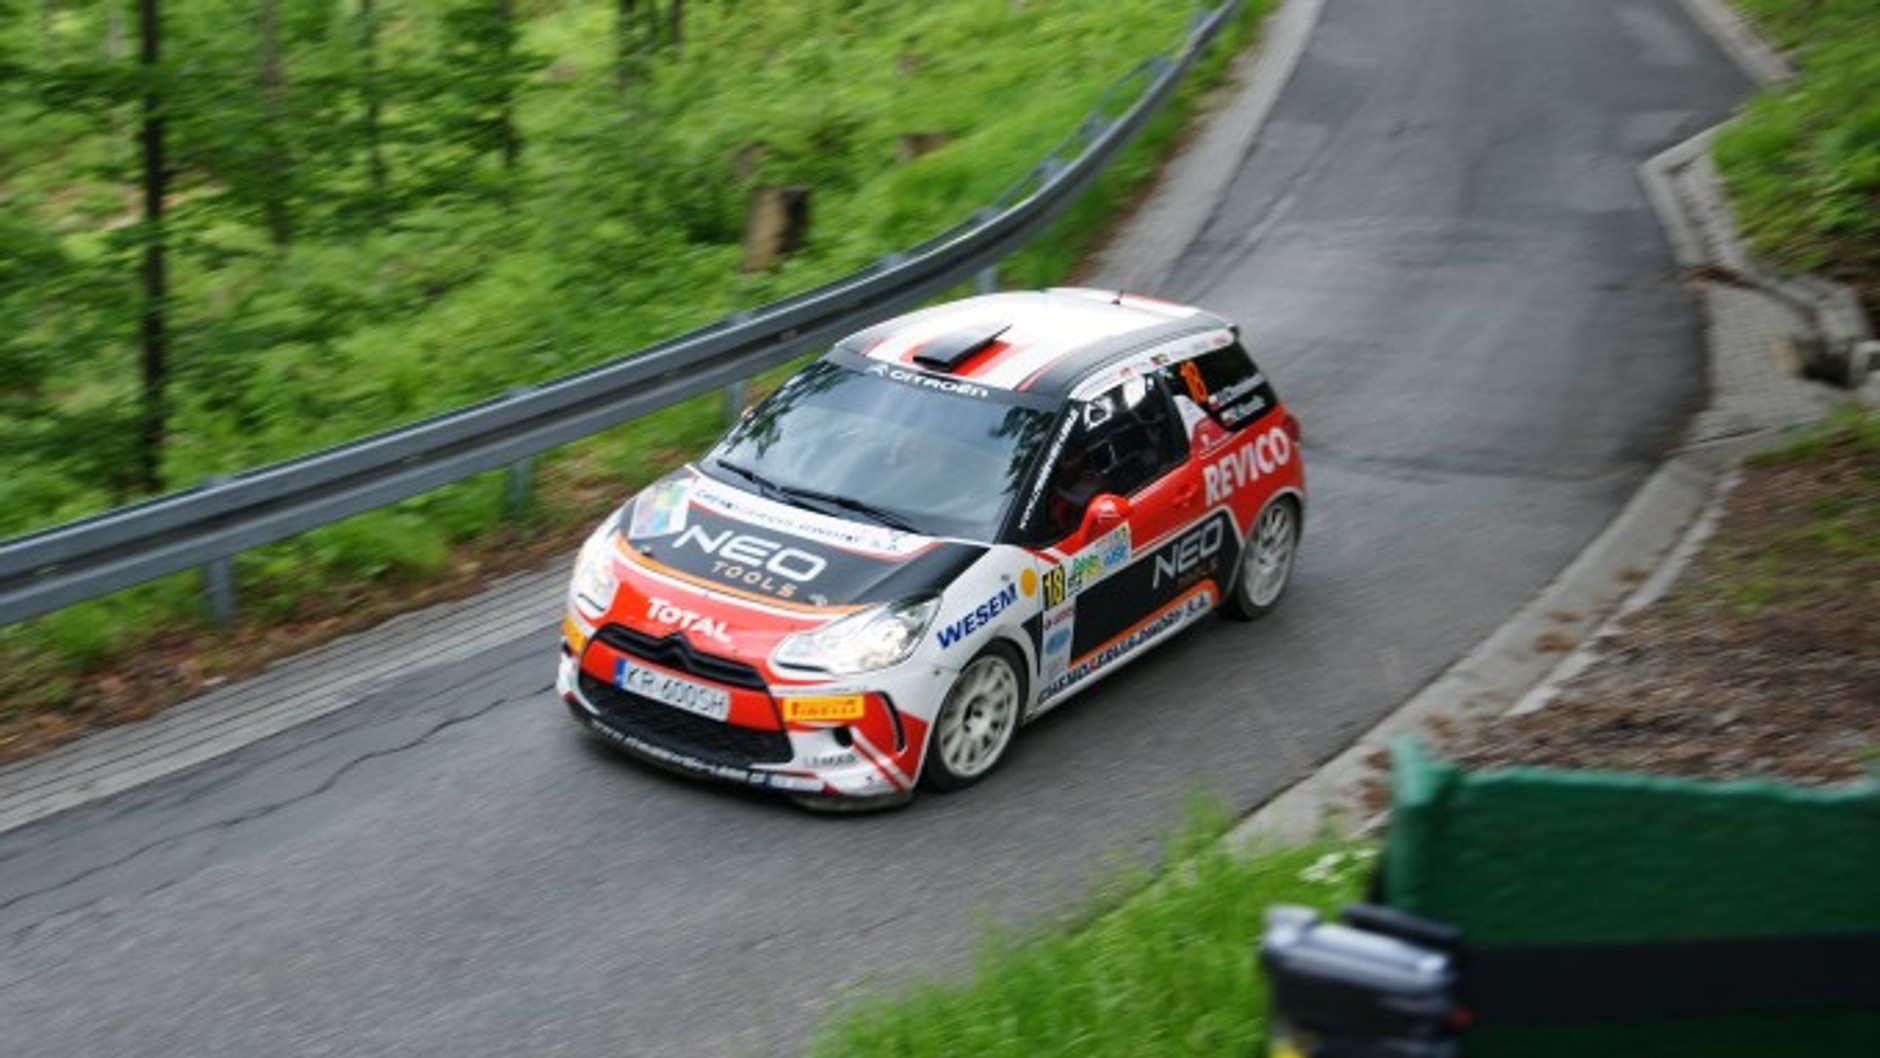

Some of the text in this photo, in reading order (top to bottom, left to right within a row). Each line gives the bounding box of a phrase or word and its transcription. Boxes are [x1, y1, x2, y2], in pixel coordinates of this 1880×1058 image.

[1180, 361, 1207, 403] 18
[1203, 428, 1290, 506] REVICO
[672, 525, 827, 582] NEO
[1153, 517, 1224, 589] NEO
[712, 560, 796, 598] TOOLS
[1044, 566, 1065, 608] 18
[937, 583, 1018, 649] WESEM
[625, 665, 659, 694] KR
